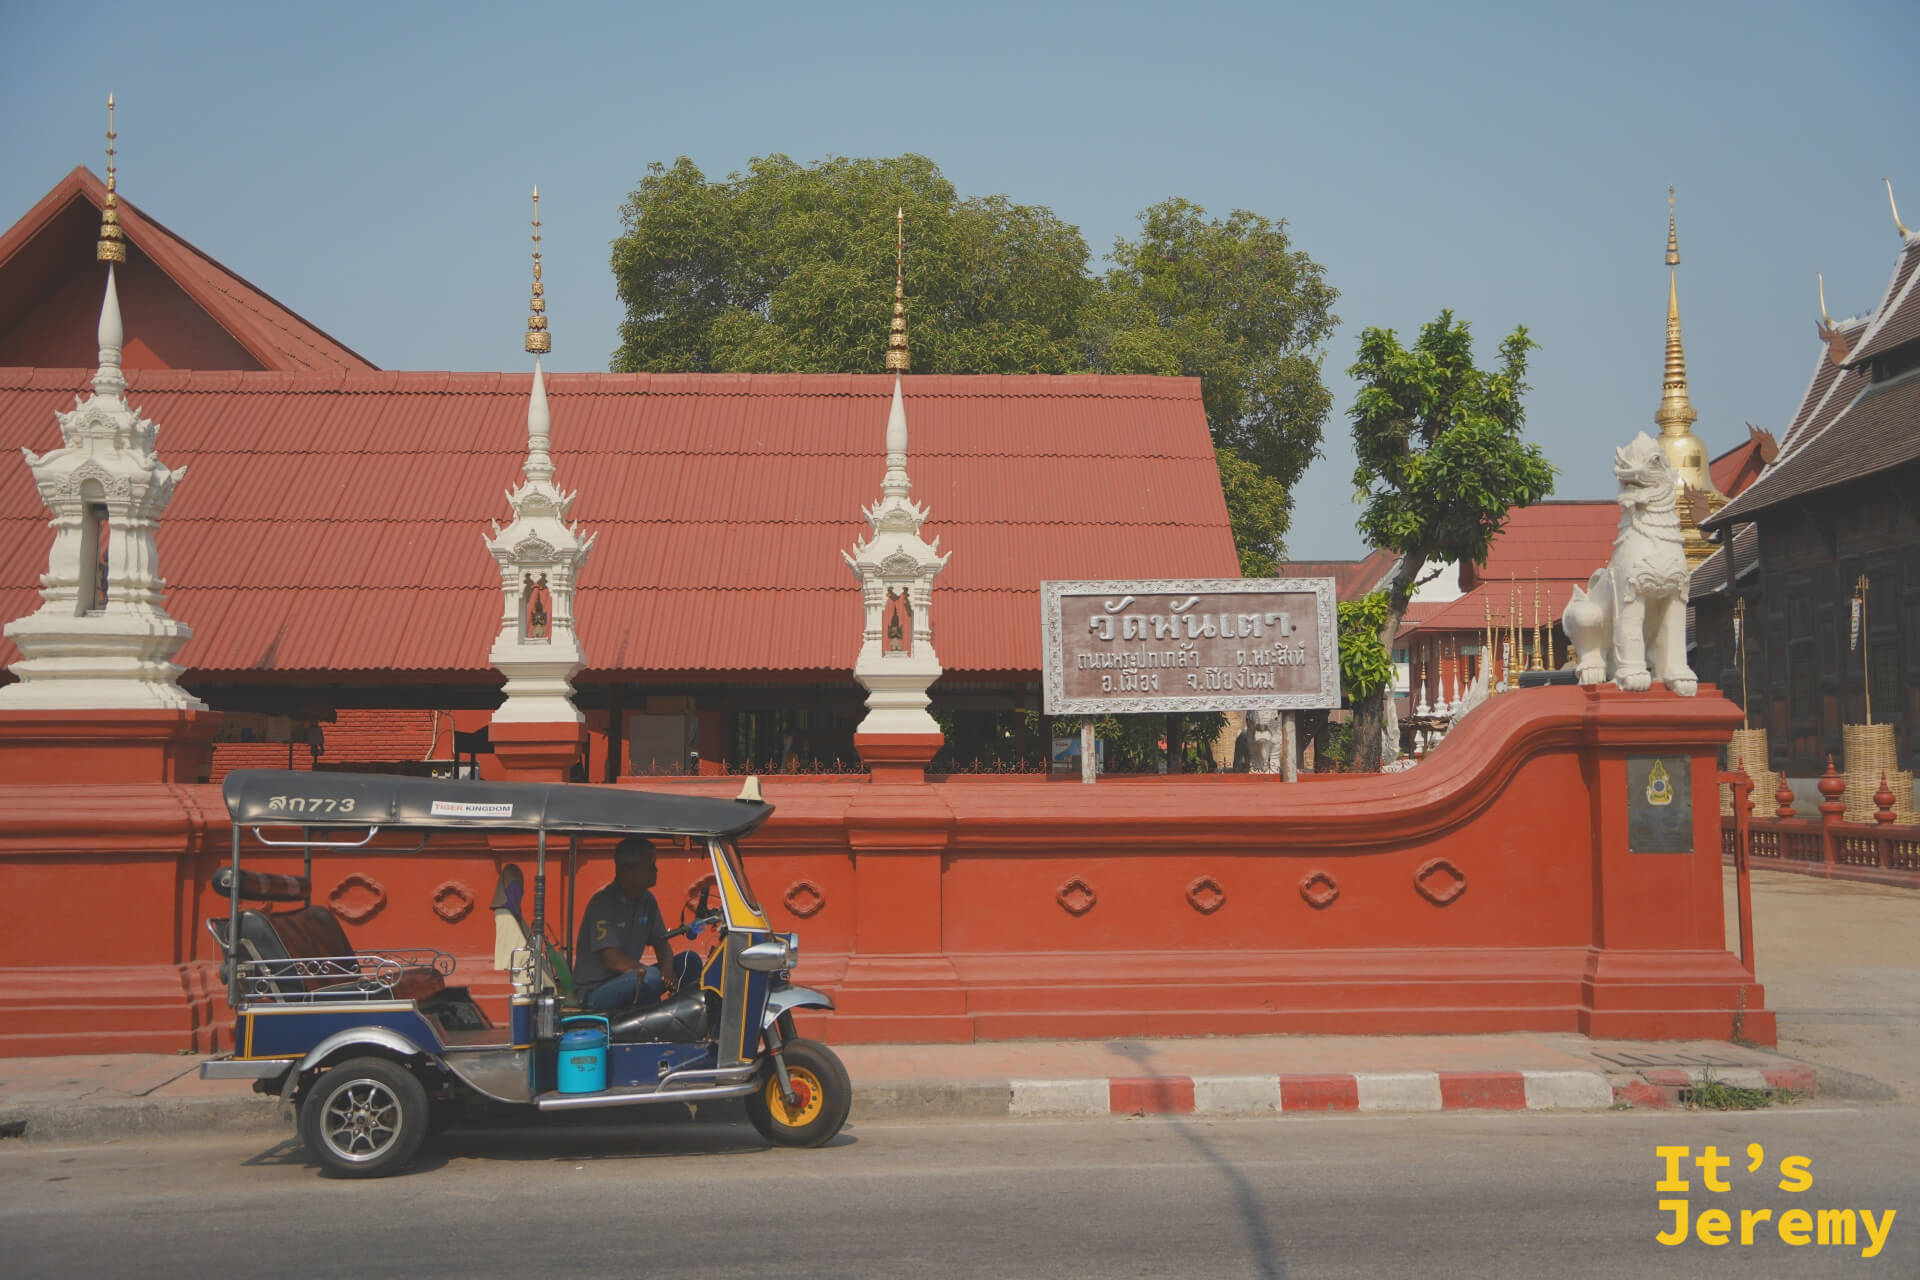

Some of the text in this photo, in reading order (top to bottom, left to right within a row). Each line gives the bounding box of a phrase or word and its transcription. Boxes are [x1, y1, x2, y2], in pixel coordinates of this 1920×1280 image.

[1089, 596, 1290, 641] วัดพันเตา
[1101, 668, 1159, 692] อ.เมือง
[435, 803, 463, 811] TIGER
[595, 920, 608, 941] 5
